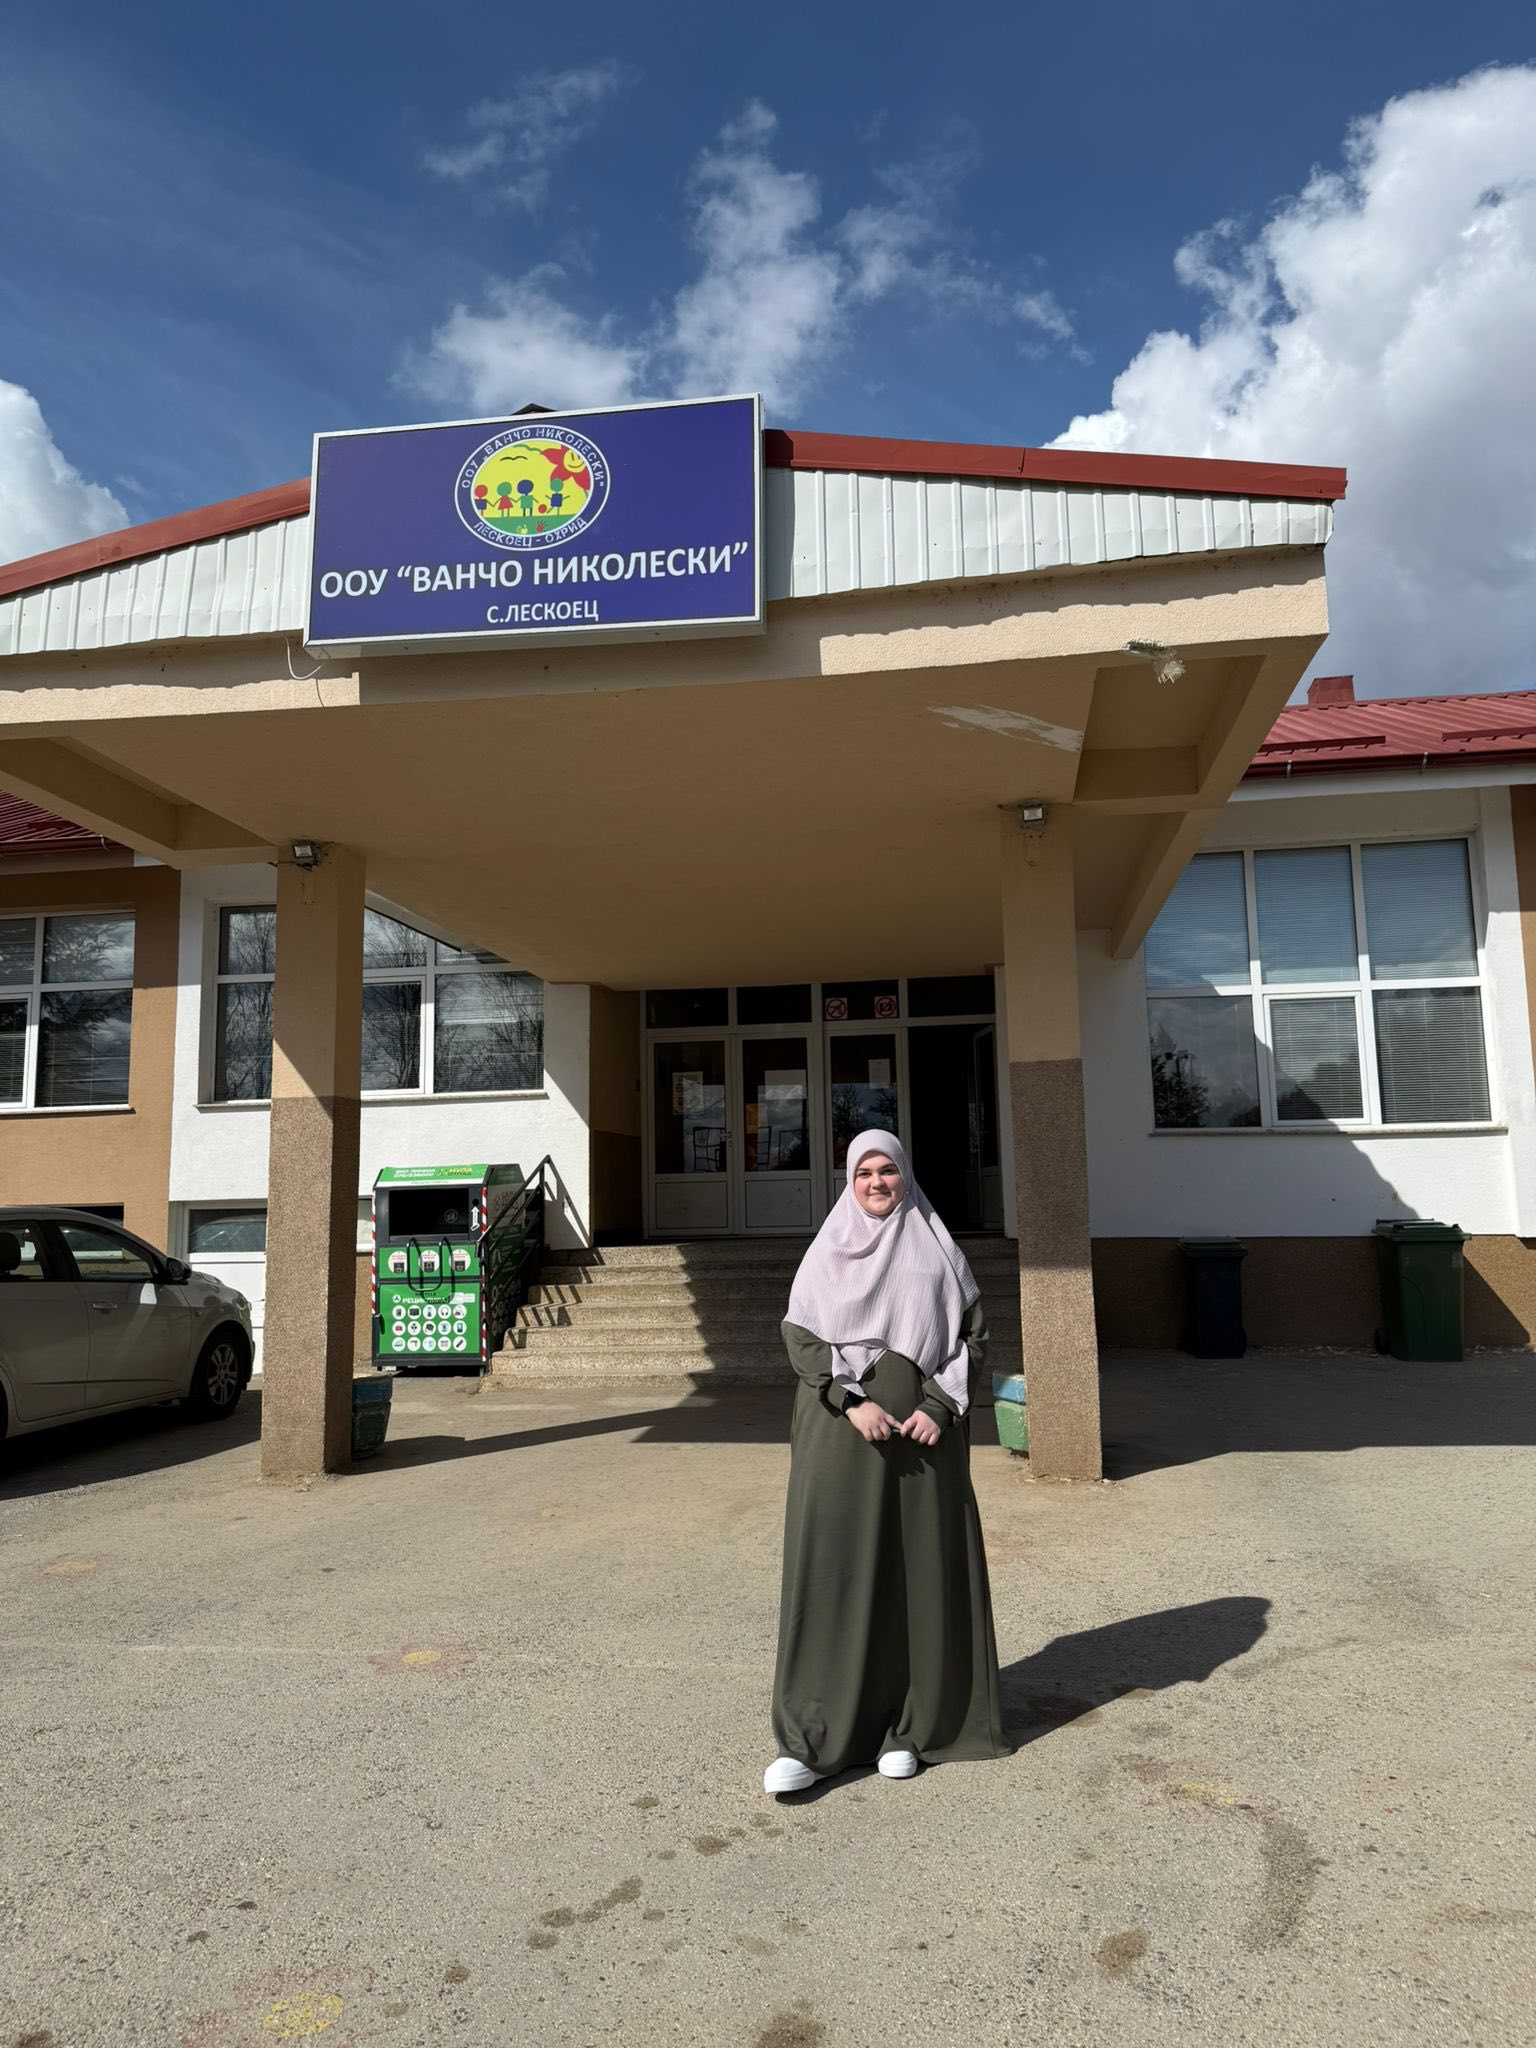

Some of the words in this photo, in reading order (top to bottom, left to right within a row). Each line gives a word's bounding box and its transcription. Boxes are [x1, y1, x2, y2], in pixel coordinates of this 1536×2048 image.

[461, 460, 479, 489] ООУ
[474, 521, 533, 548] ЛЕСКОЕЦ
[545, 517, 588, 543] ОХРИД
[320, 568, 389, 599] ООУ
[397, 558, 523, 593] “ВАНЧО
[533, 541, 749, 586] НИКОЛЕСКИ”
[486, 599, 599, 624] С.ЛЕСКОЕЦ
